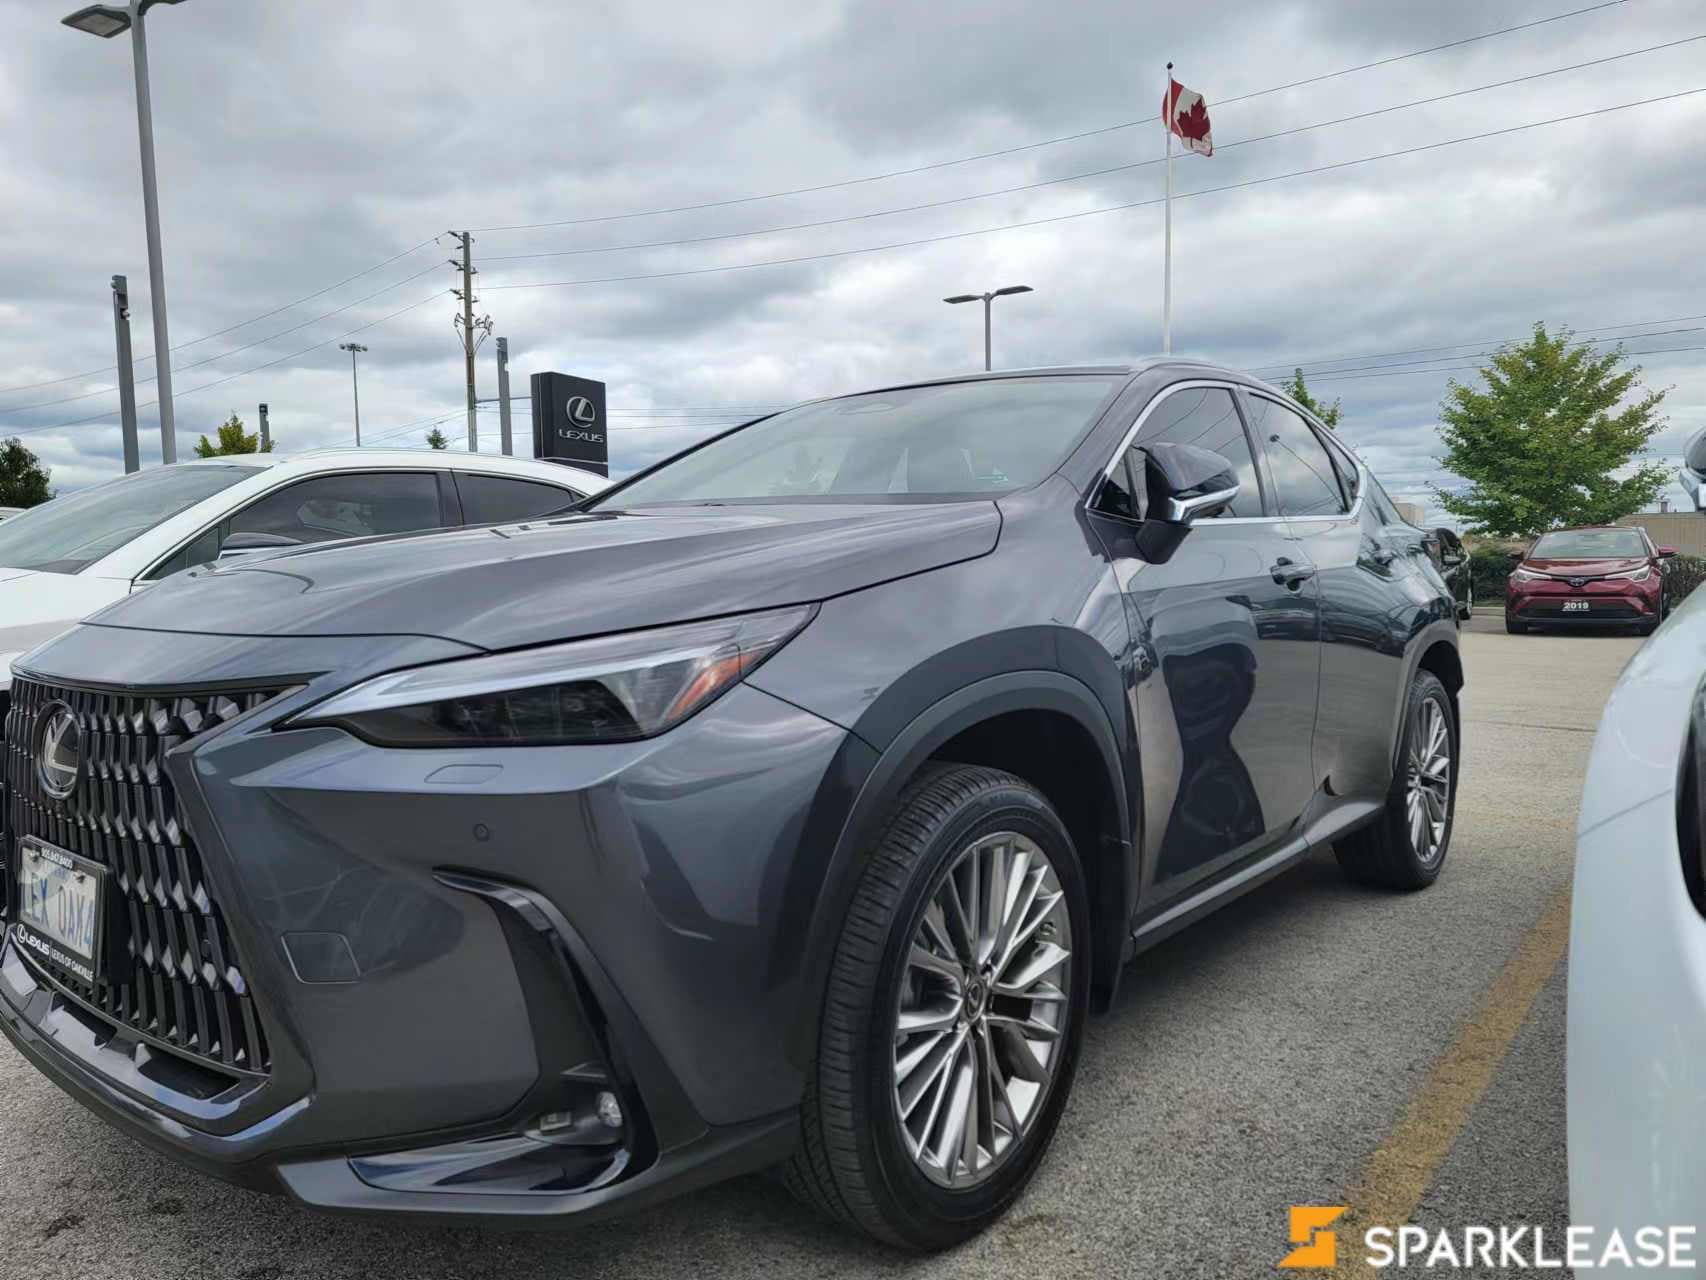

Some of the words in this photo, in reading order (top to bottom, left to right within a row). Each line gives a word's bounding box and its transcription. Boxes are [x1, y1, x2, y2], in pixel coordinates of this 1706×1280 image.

[559, 429, 604, 443] LEXUS
[1563, 601, 1589, 609] 2019
[25, 932, 50, 956] LEXUS
